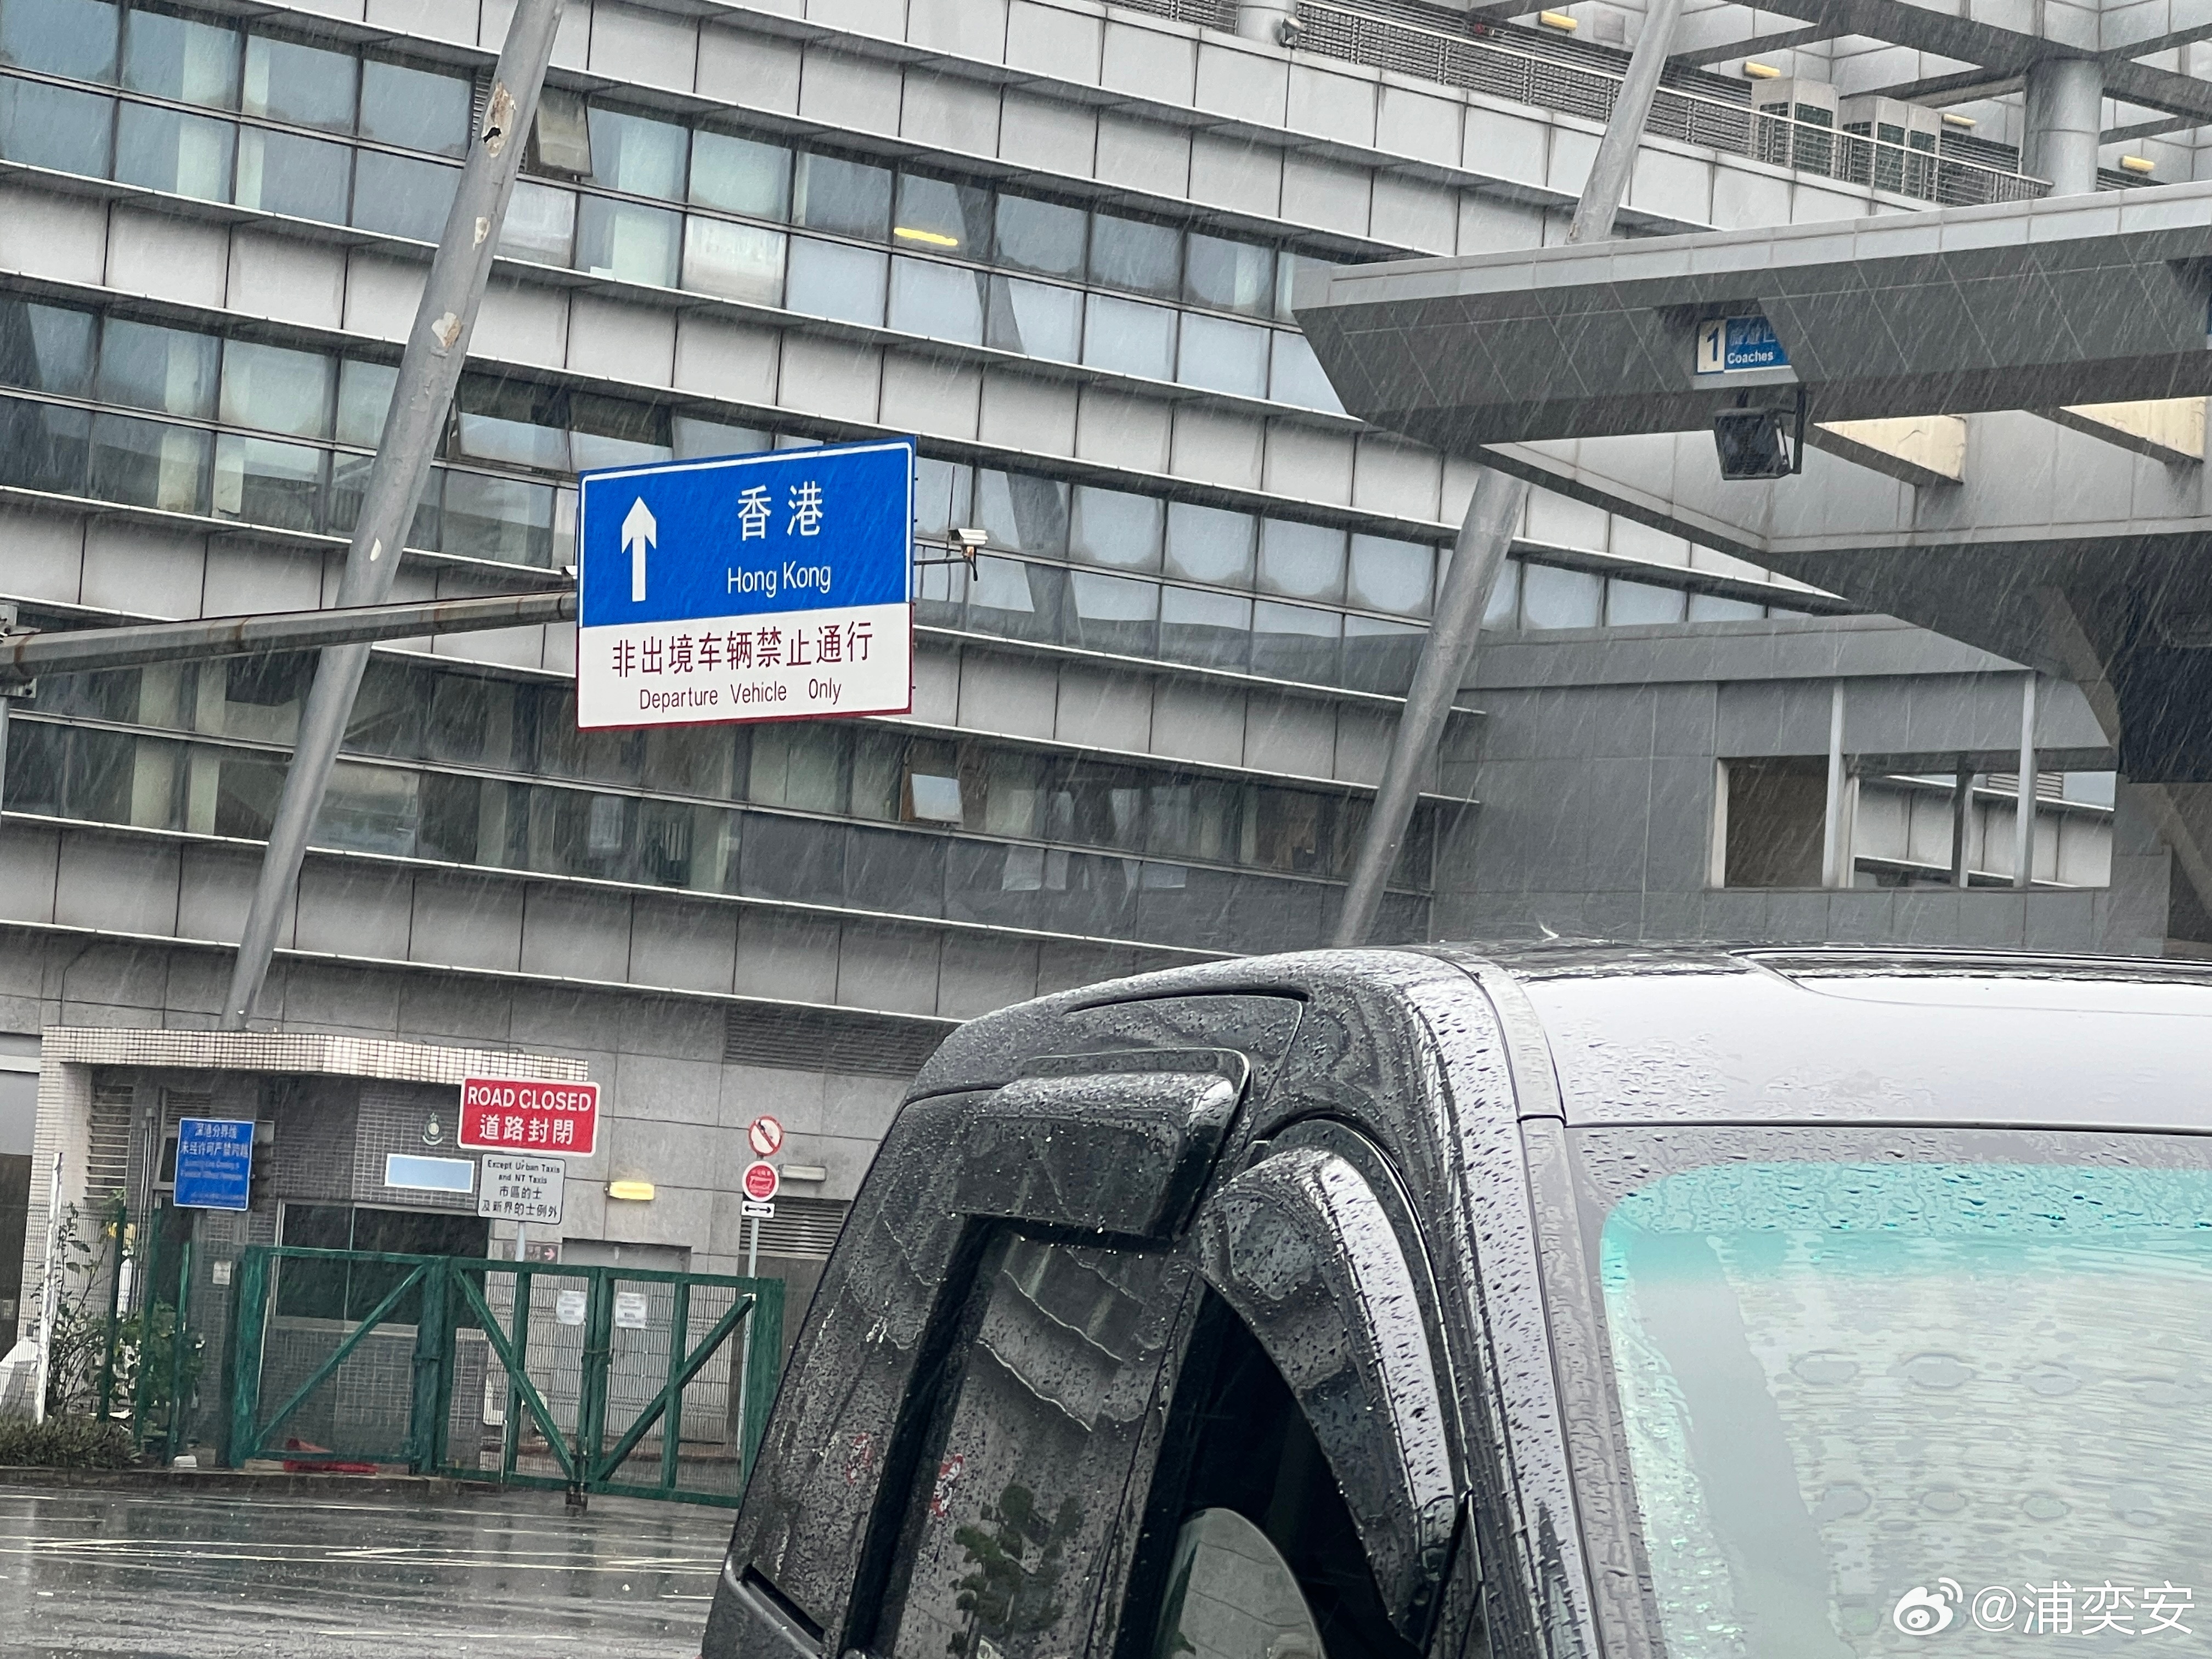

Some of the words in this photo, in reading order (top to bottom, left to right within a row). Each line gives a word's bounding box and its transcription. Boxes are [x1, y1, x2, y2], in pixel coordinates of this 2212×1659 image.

[1707, 327, 1720, 362] 1
[1728, 349, 1774, 364] Coaches
[737, 481, 823, 541] 香港
[727, 567, 777, 598] Hong
[783, 561, 831, 594] Kong
[612, 620, 873, 678] 非出境车辆禁止通行
[640, 686, 718, 712] Departure
[730, 680, 787, 705] Vehicle
[809, 678, 842, 705] Only
[467, 1086, 515, 1108] ROAD
[518, 1089, 592, 1111] CLOSED
[479, 1114, 574, 1145] 道路封閉
[487, 1159, 512, 1170] Except
[515, 1162, 539, 1171] Urban
[541, 1164, 560, 1173] Taxis
[498, 1173, 511, 1182] and
[529, 1176, 548, 1184] Taxis
[499, 1186, 543, 1200] 市區的士
[481, 1200, 557, 1218] 及新界的士例外
